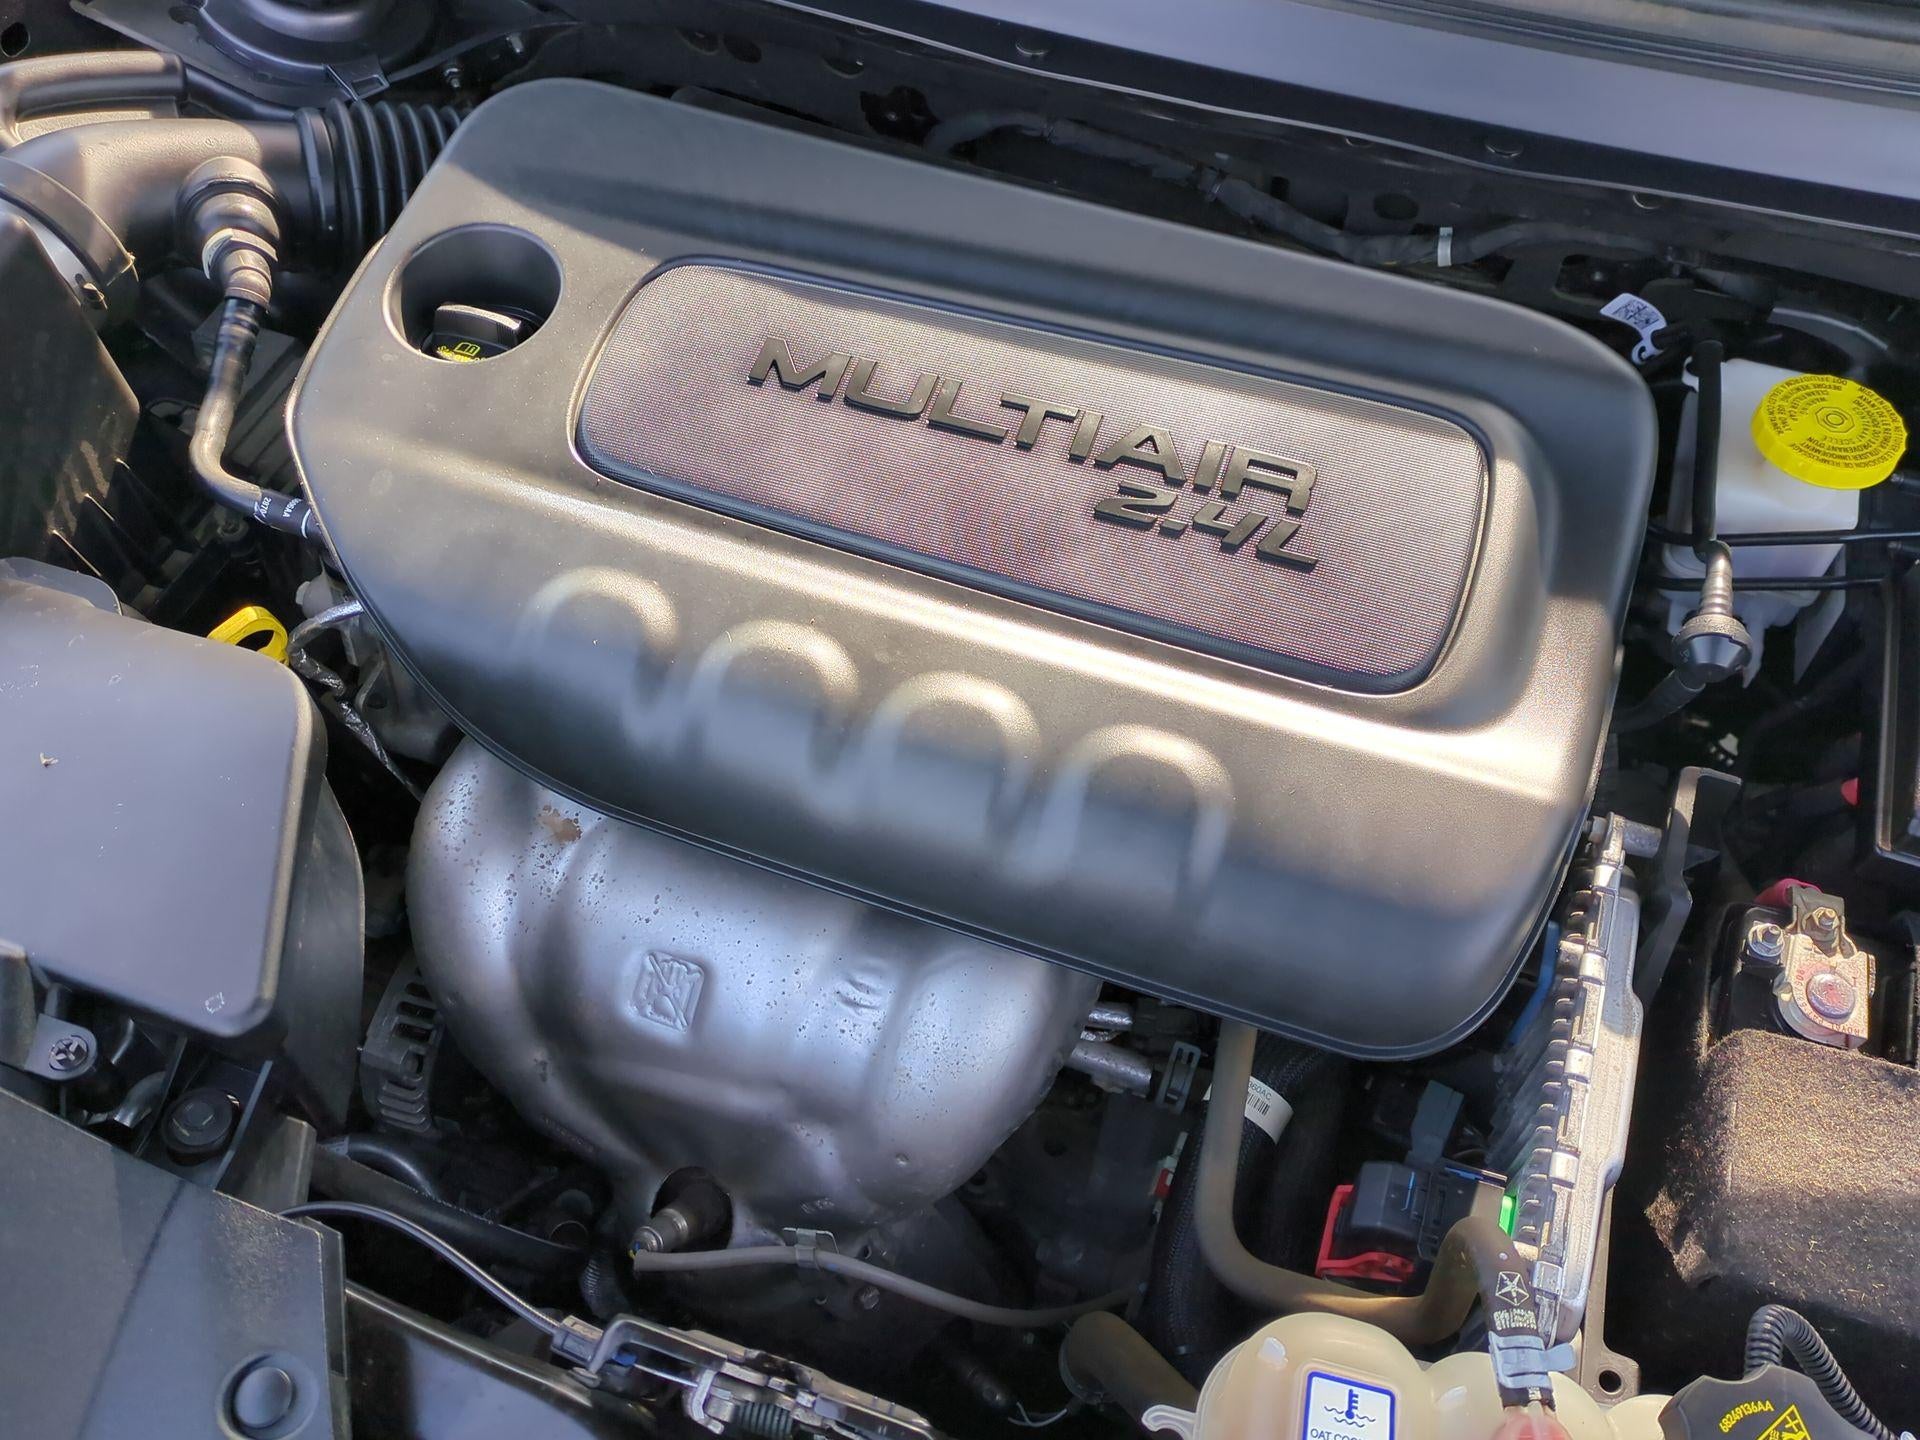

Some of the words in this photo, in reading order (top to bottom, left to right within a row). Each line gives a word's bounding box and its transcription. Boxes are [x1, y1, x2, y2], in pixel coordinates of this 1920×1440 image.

[747, 336, 1317, 516] MULTIAIR
[1093, 480, 1319, 567] 2.4L
[1310, 1428, 1332, 1440] OAT
[1719, 1400, 1774, 1433] 68249136AA
